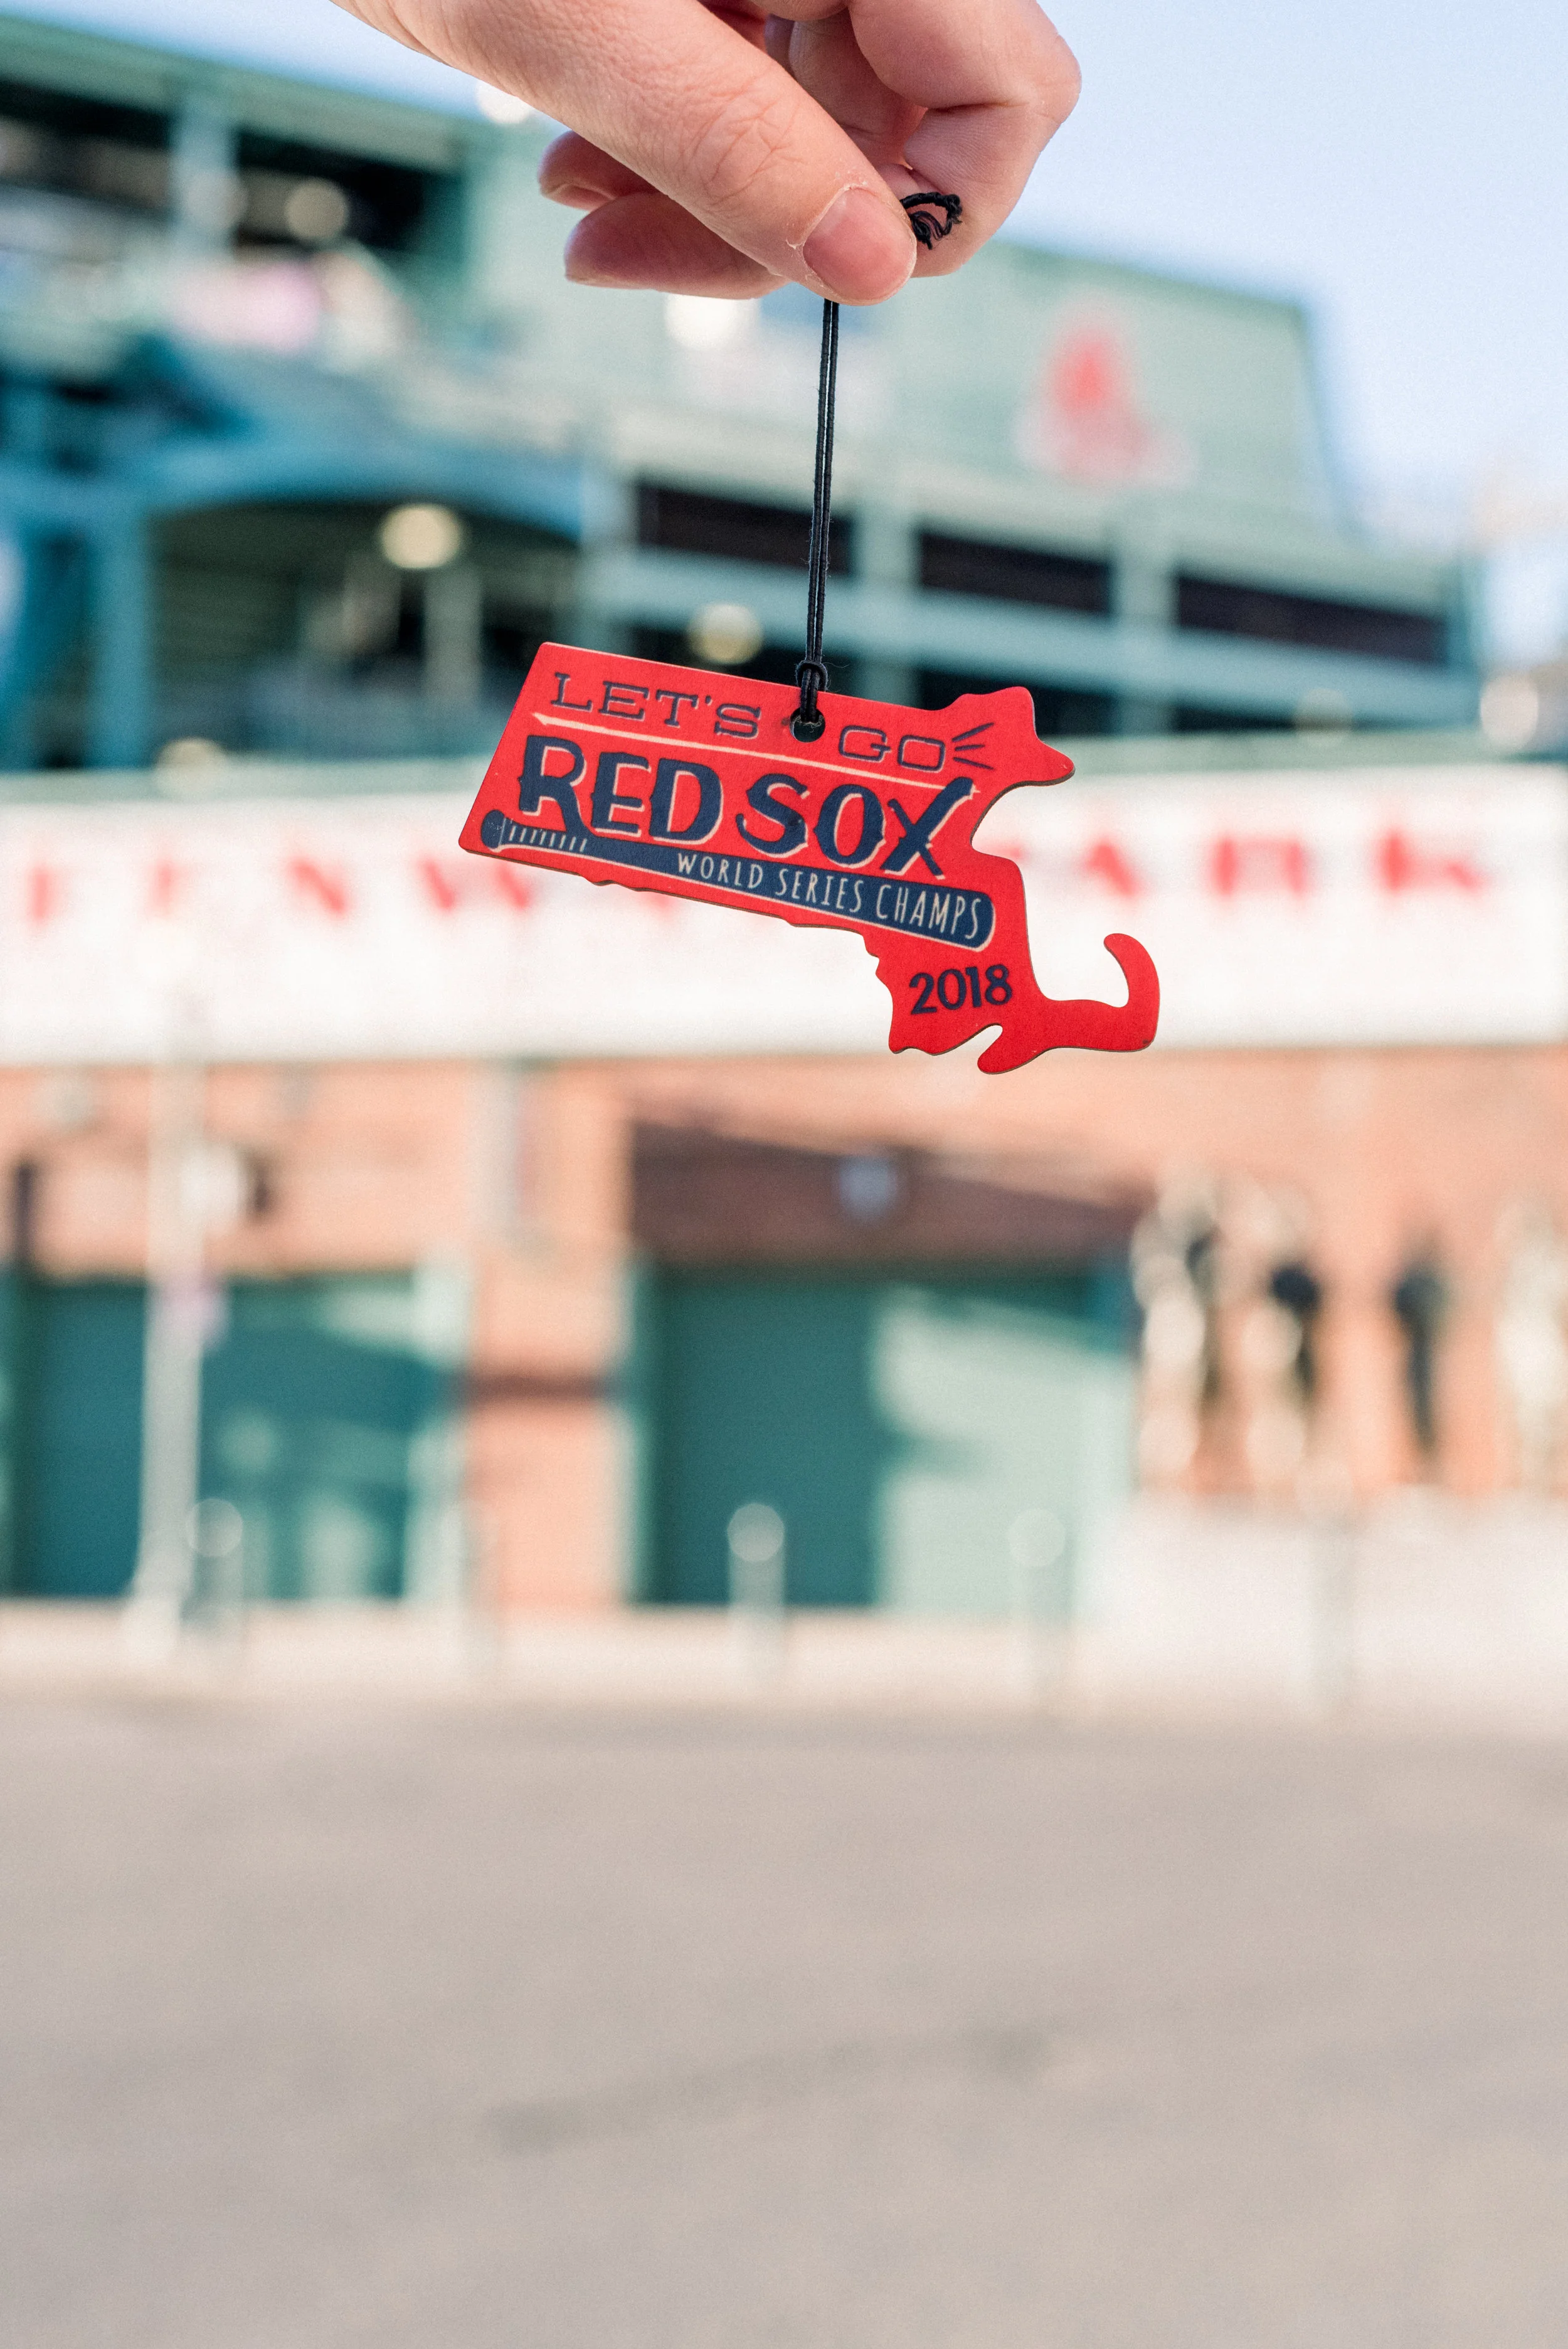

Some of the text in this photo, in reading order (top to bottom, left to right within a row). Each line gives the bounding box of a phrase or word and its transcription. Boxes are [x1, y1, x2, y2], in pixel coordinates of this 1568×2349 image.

[551, 672, 946, 772] LET'S GO
[518, 735, 980, 879] RED SOX
[678, 852, 763, 888] WORLD
[775, 868, 864, 913] SERIES
[877, 884, 980, 940] CHAMPS
[909, 964, 1012, 1015] 2018
